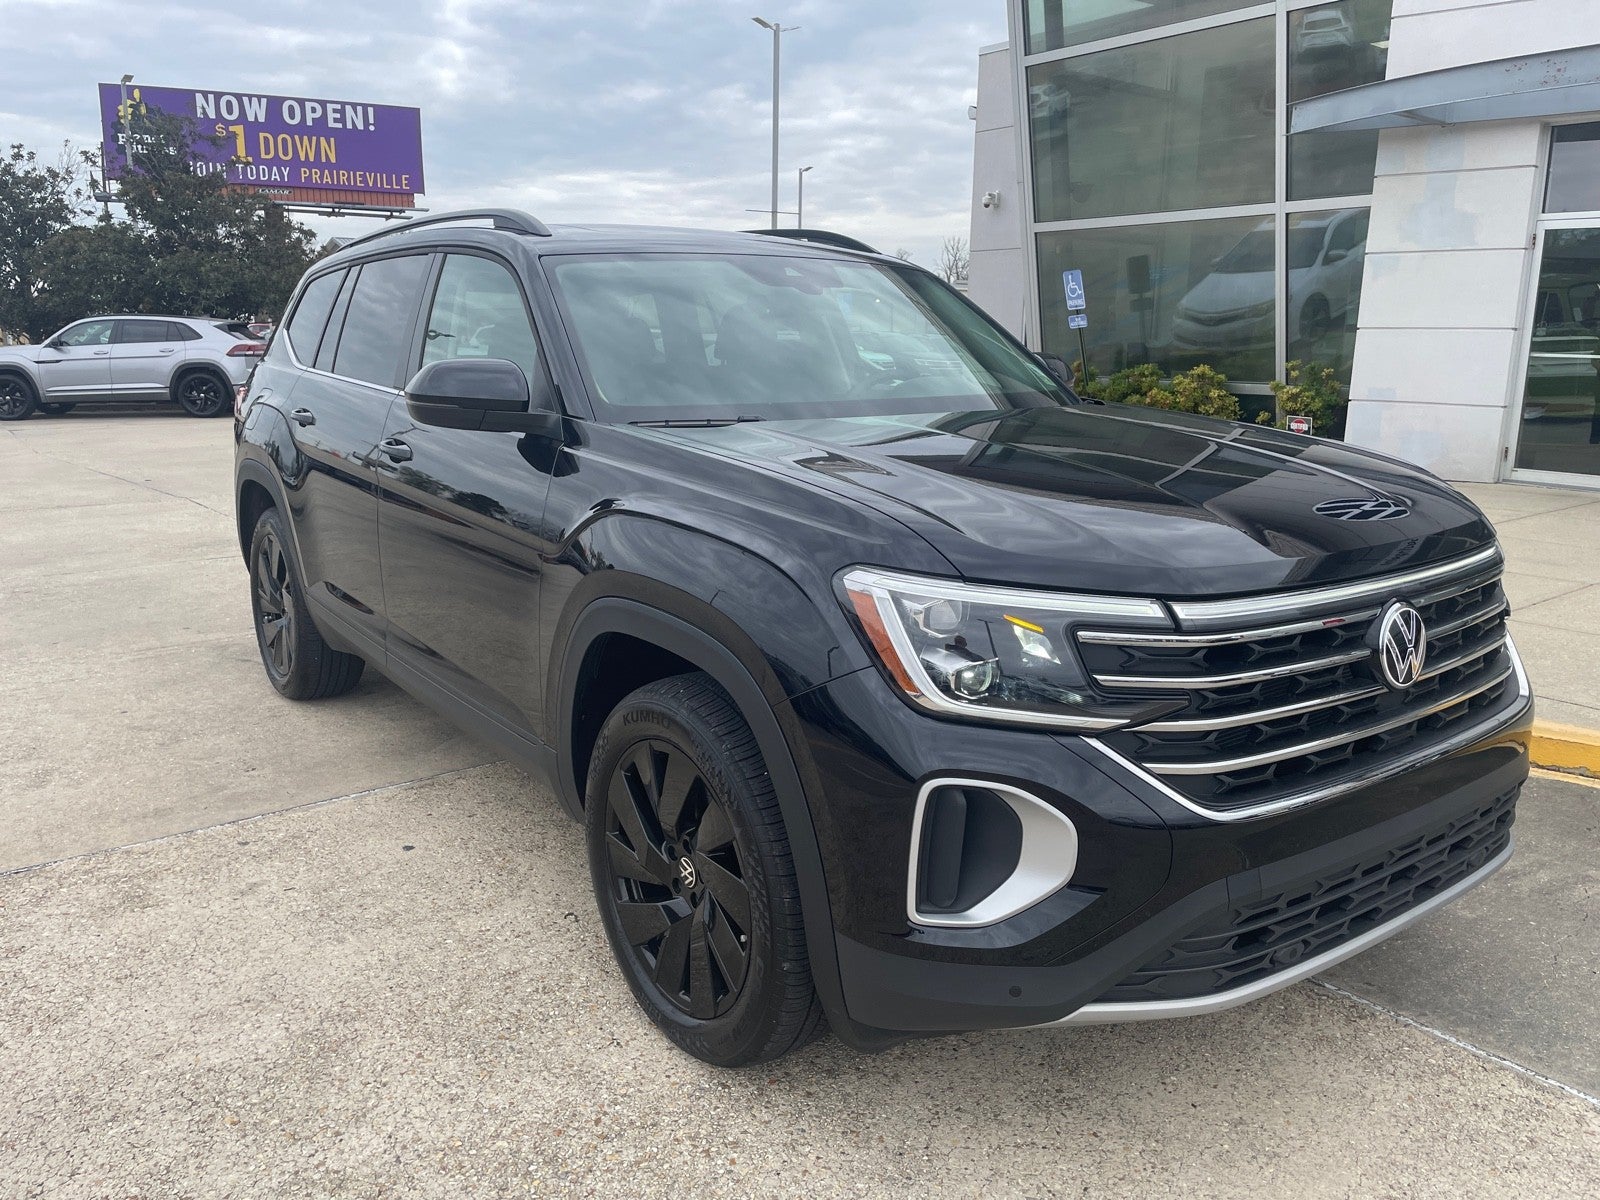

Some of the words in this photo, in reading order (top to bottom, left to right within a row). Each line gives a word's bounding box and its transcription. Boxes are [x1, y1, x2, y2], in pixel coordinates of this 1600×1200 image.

[195, 93, 267, 123] NOW
[282, 99, 375, 131] OPEN!
[259, 132, 337, 163] DOWN
[235, 163, 290, 182] TODAY
[301, 168, 410, 190] PRAIRIEVILLE
[622, 710, 671, 730] KUMHO
